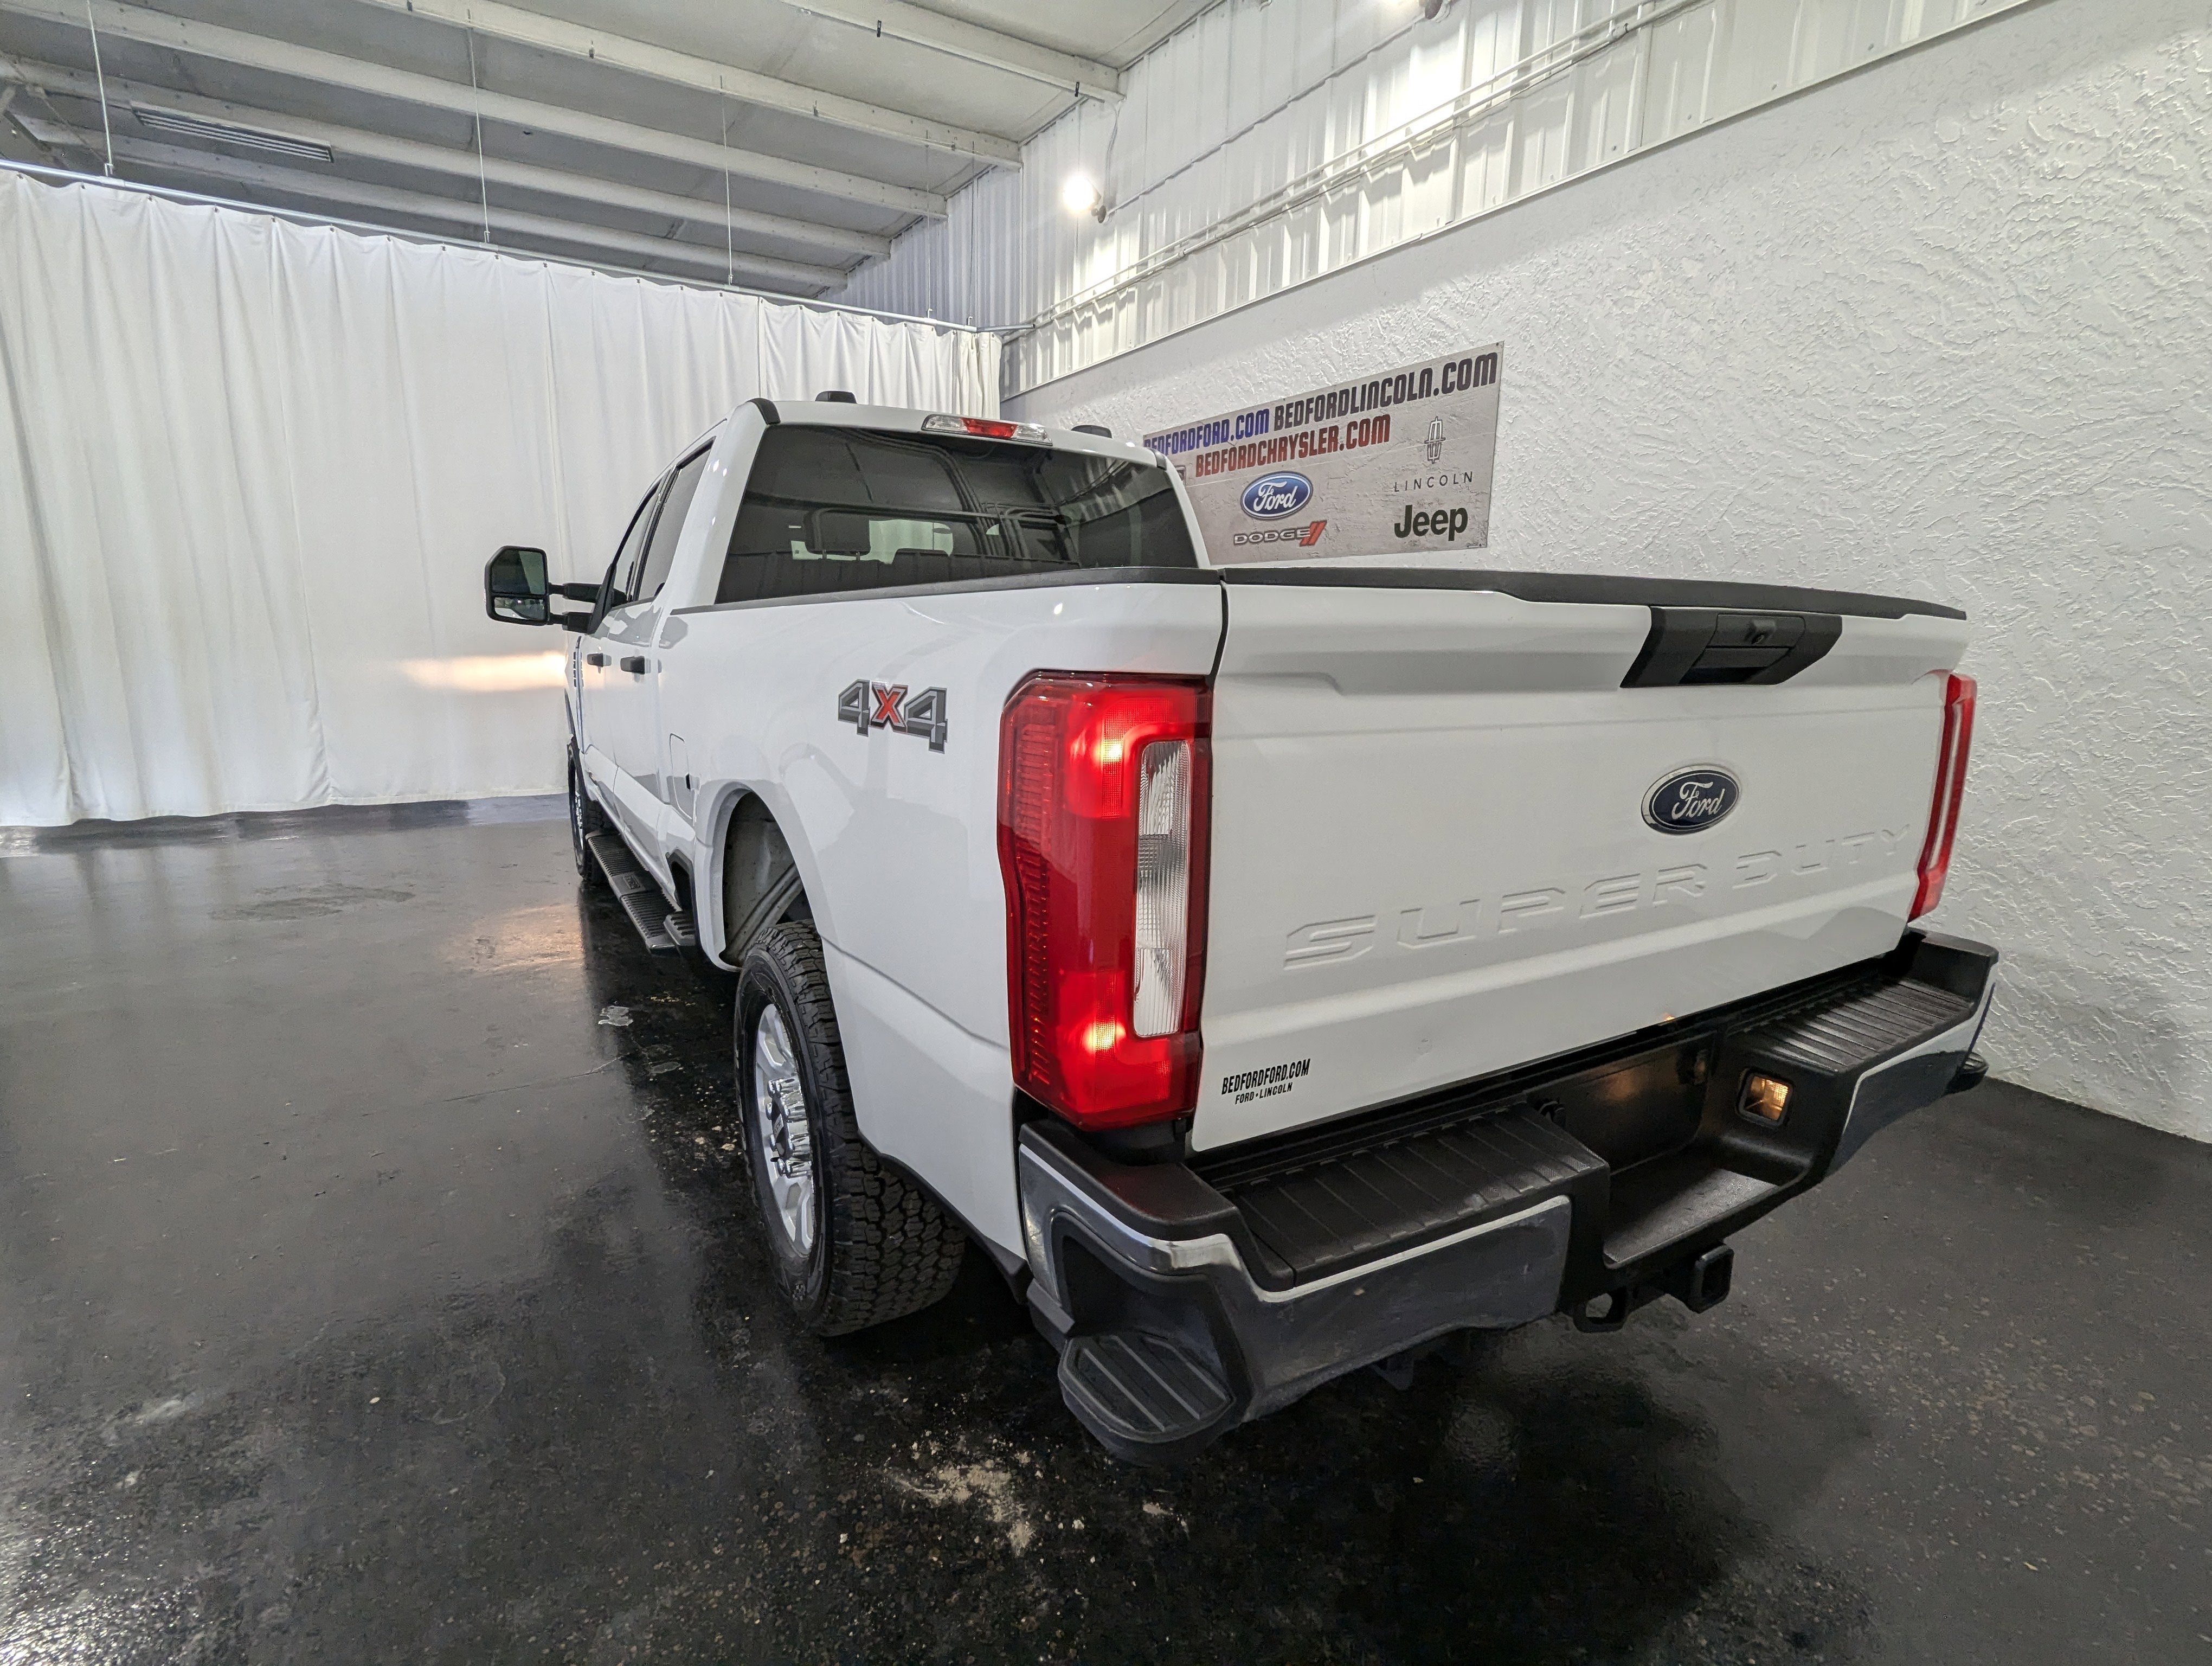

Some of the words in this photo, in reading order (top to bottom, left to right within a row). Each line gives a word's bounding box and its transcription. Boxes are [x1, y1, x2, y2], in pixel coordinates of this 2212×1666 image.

[1274, 352, 1498, 431] BEDFORDLINCOLN.COM
[1195, 414, 1391, 478] BEDFORDCHRYSLER.COM
[1253, 481, 1298, 511] Ford
[1394, 471, 1473, 492] LINCOLN
[1233, 527, 1311, 546] DODGE
[1394, 504, 1468, 541] Jeep
[1671, 781, 1726, 820] Ford
[1283, 863, 1709, 971] SUPER
[1732, 823, 1911, 889] DUTY
[1221, 1058, 1311, 1095] BEDFORDFORD.COM
